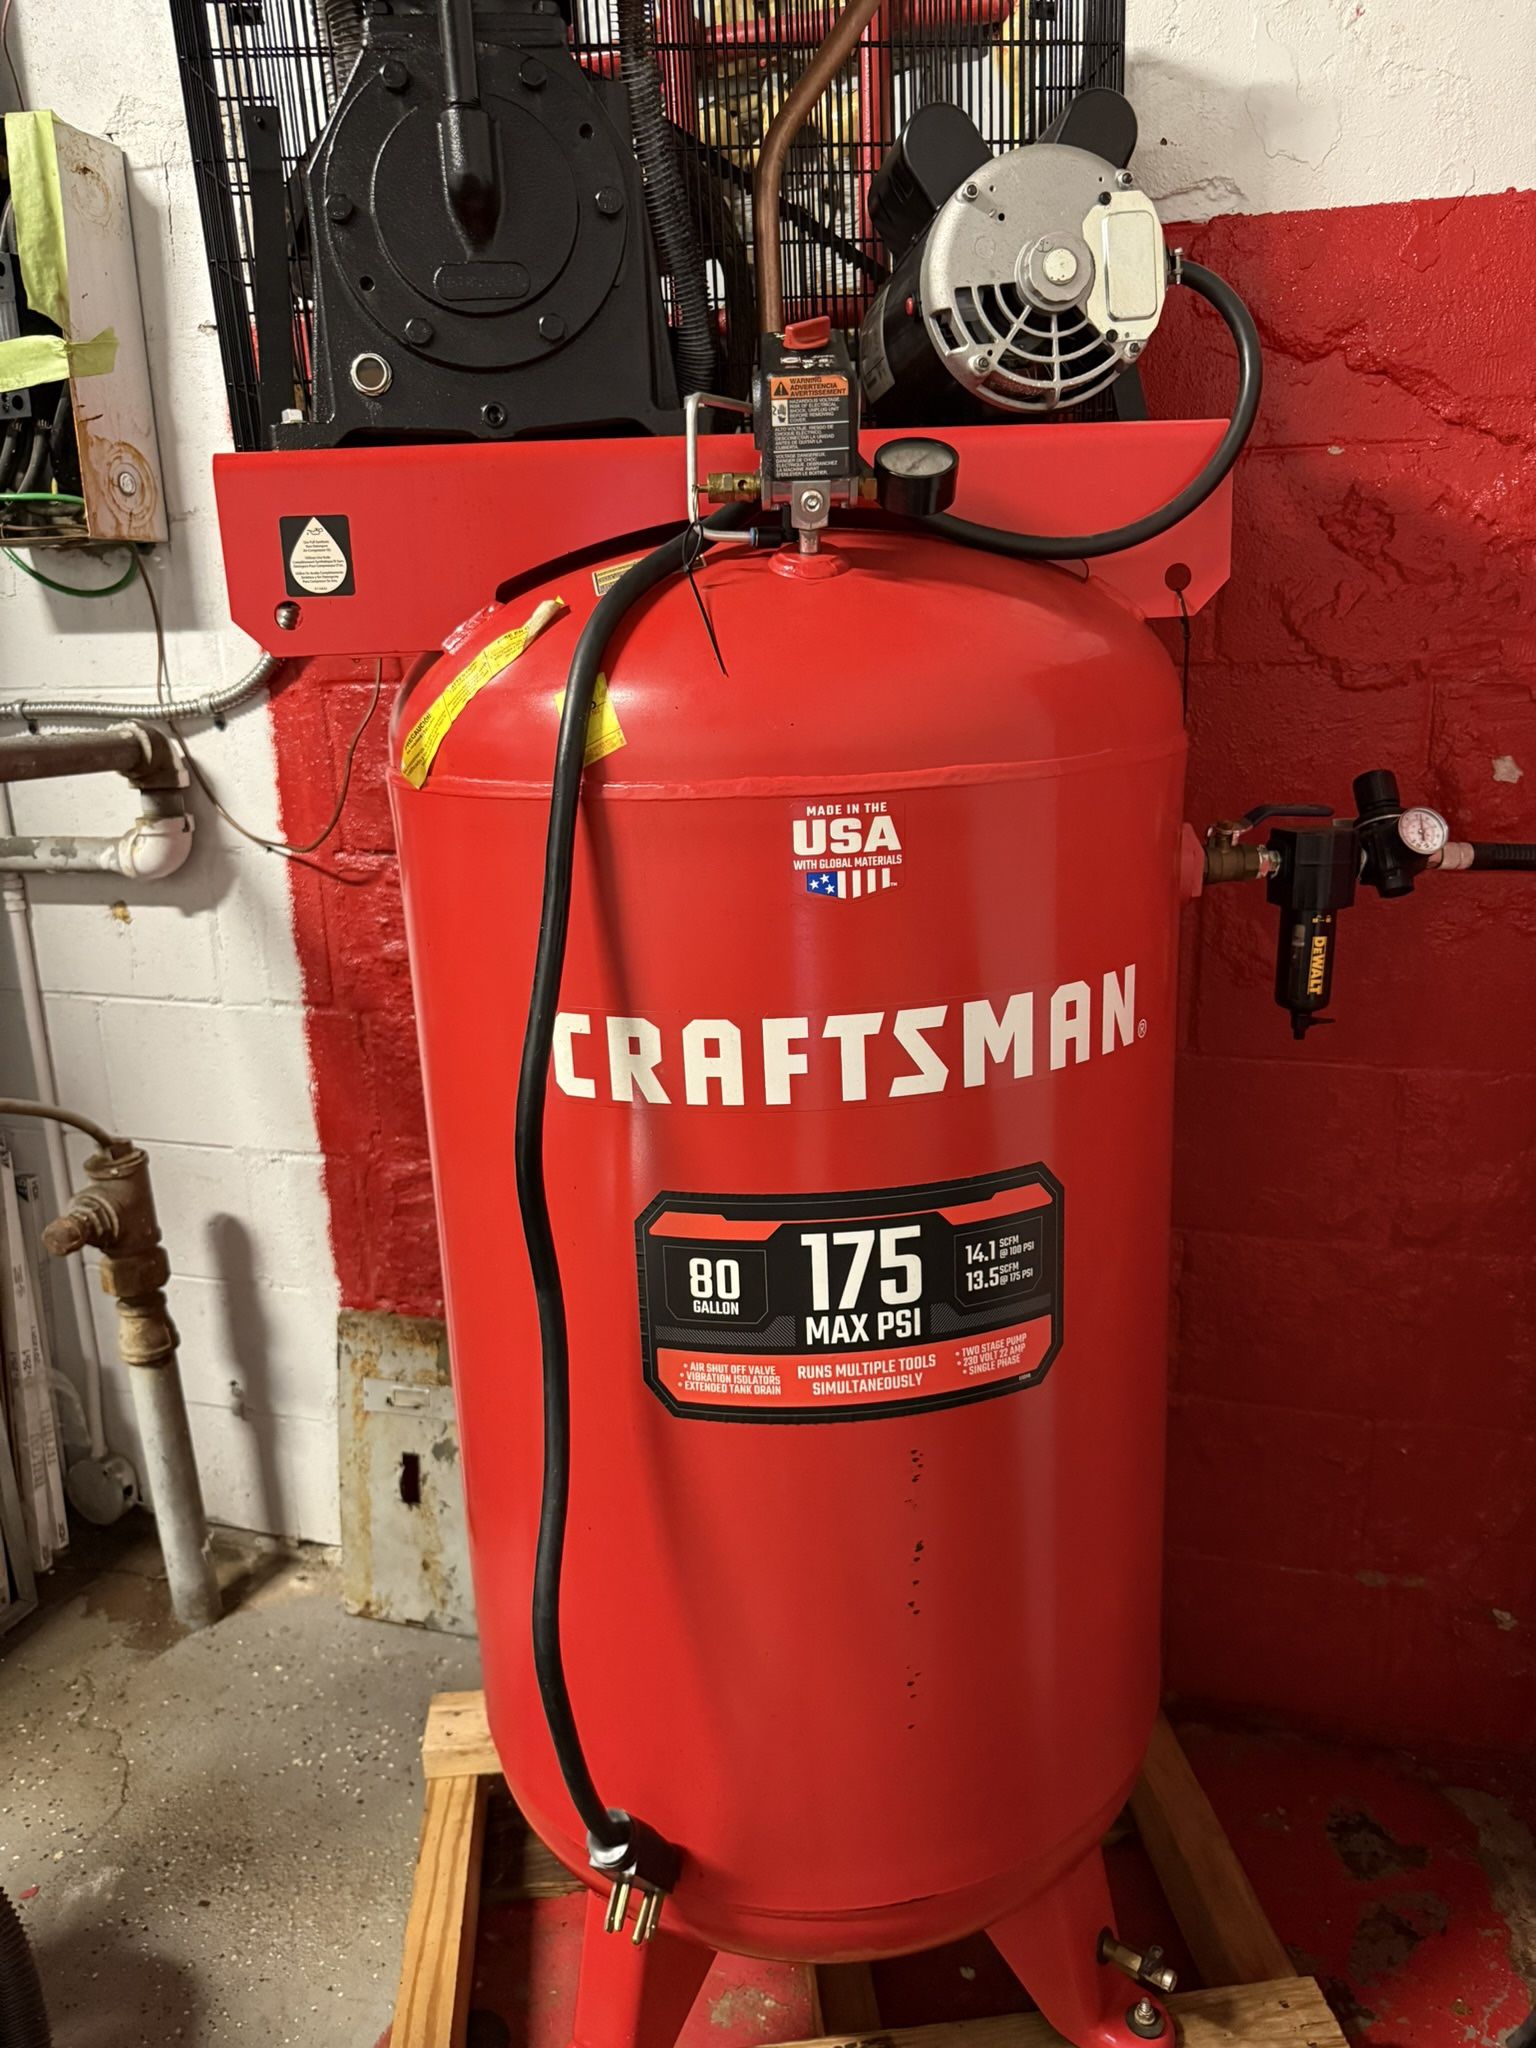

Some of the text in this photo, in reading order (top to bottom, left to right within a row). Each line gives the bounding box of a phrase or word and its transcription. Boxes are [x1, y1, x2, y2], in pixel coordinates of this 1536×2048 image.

[790, 389, 846, 397] AVERTISSEMENT
[806, 802, 887, 816] MADE IN THE
[793, 815, 902, 856] USA
[793, 854, 902, 870] WITH GLOBAL MATERIALS
[1308, 936, 1327, 995] DEWALT
[965, 1234, 1020, 1265] 14.1 SCFM
[999, 1240, 1035, 1259] @ 100 PSI
[689, 1257, 741, 1300] 80
[801, 1225, 922, 1311] 175
[965, 1261, 1020, 1292] 13.5 SCFM
[999, 1267, 1034, 1285] @ 175 PSI
[693, 1300, 740, 1315] GALLON
[806, 1307, 921, 1346] MAX PSI
[961, 1333, 1027, 1357] TWO STAGE PUMP
[963, 1342, 1026, 1367] 230 VOLT 22 AMP
[690, 1361, 776, 1376] AIR SHUT OFF VALVE
[797, 1354, 937, 1379] RUNS MULTIPLE TOOLS
[969, 1354, 1020, 1375] SINGLE PHASE
[684, 1381, 781, 1396] EXTENDED TANK DRAIN
[686, 1371, 781, 1386] VIBRATION ISOLATORS
[812, 1372, 923, 1396] SIMULTANEOUSLY
